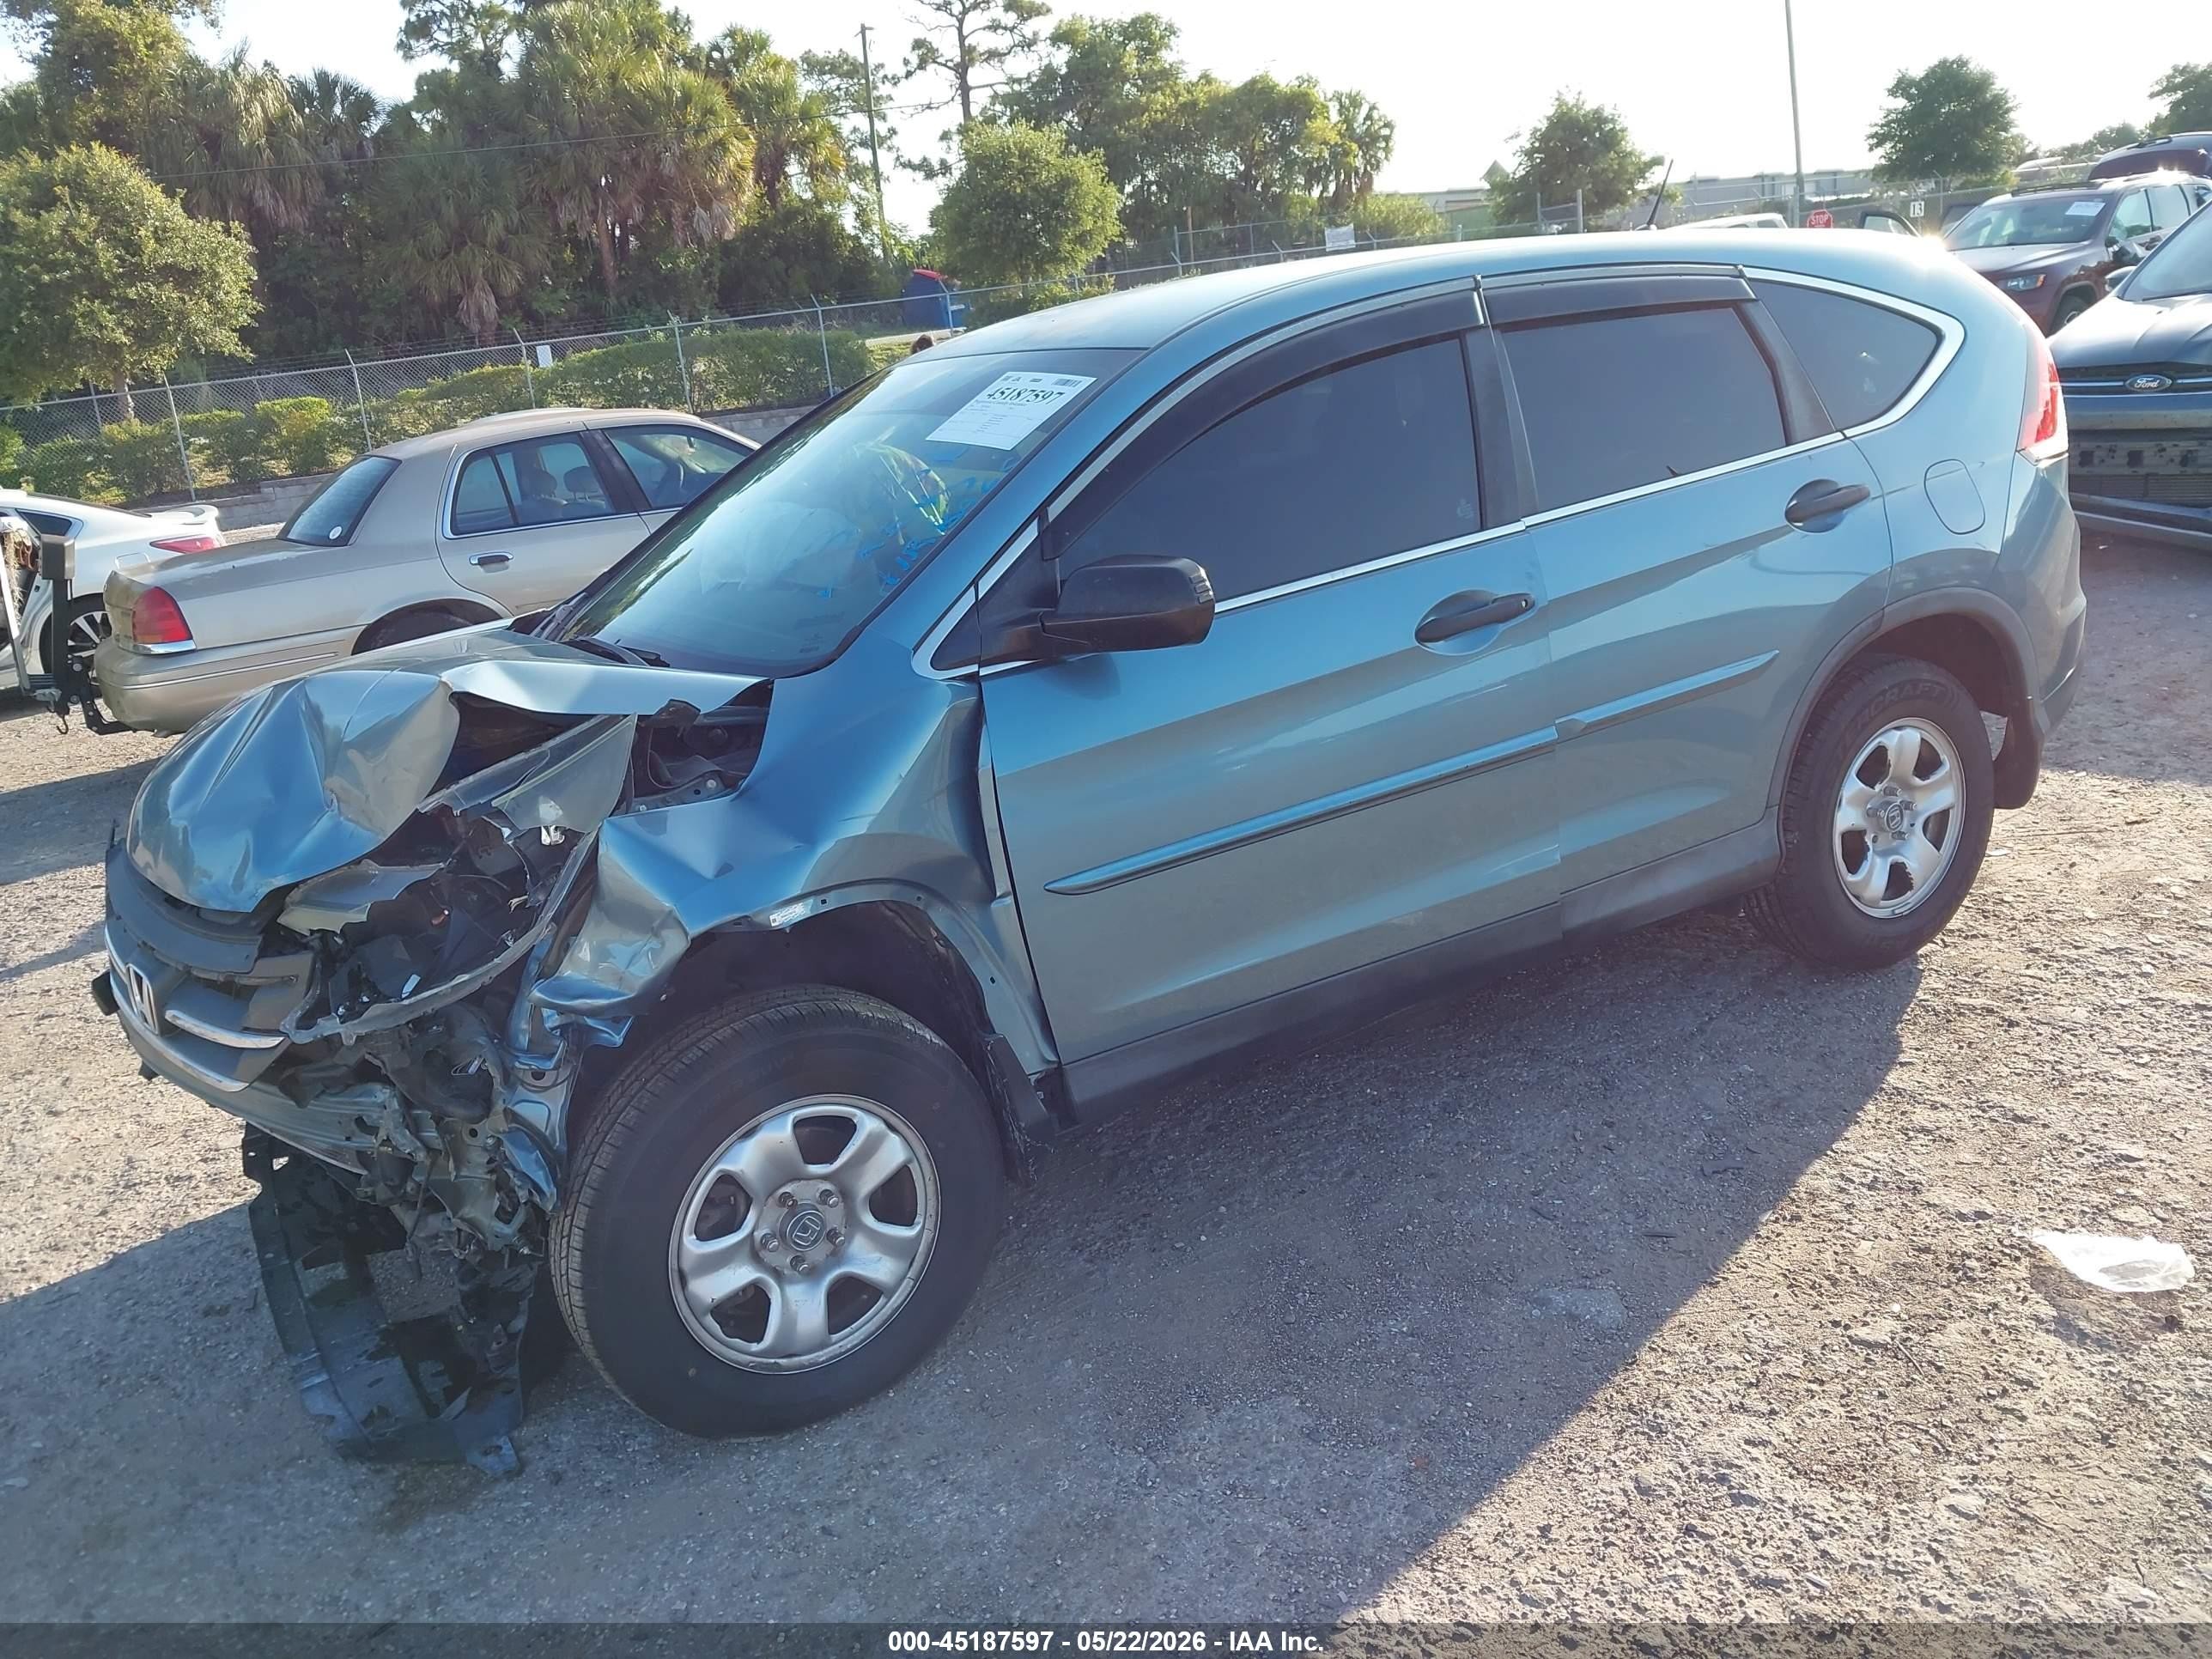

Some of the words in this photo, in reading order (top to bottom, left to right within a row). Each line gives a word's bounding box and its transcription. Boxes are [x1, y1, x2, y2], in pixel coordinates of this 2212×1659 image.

[1811, 213, 1828, 225] STOP
[2134, 377, 2160, 389] Ford
[986, 386, 1066, 405] 45187597
